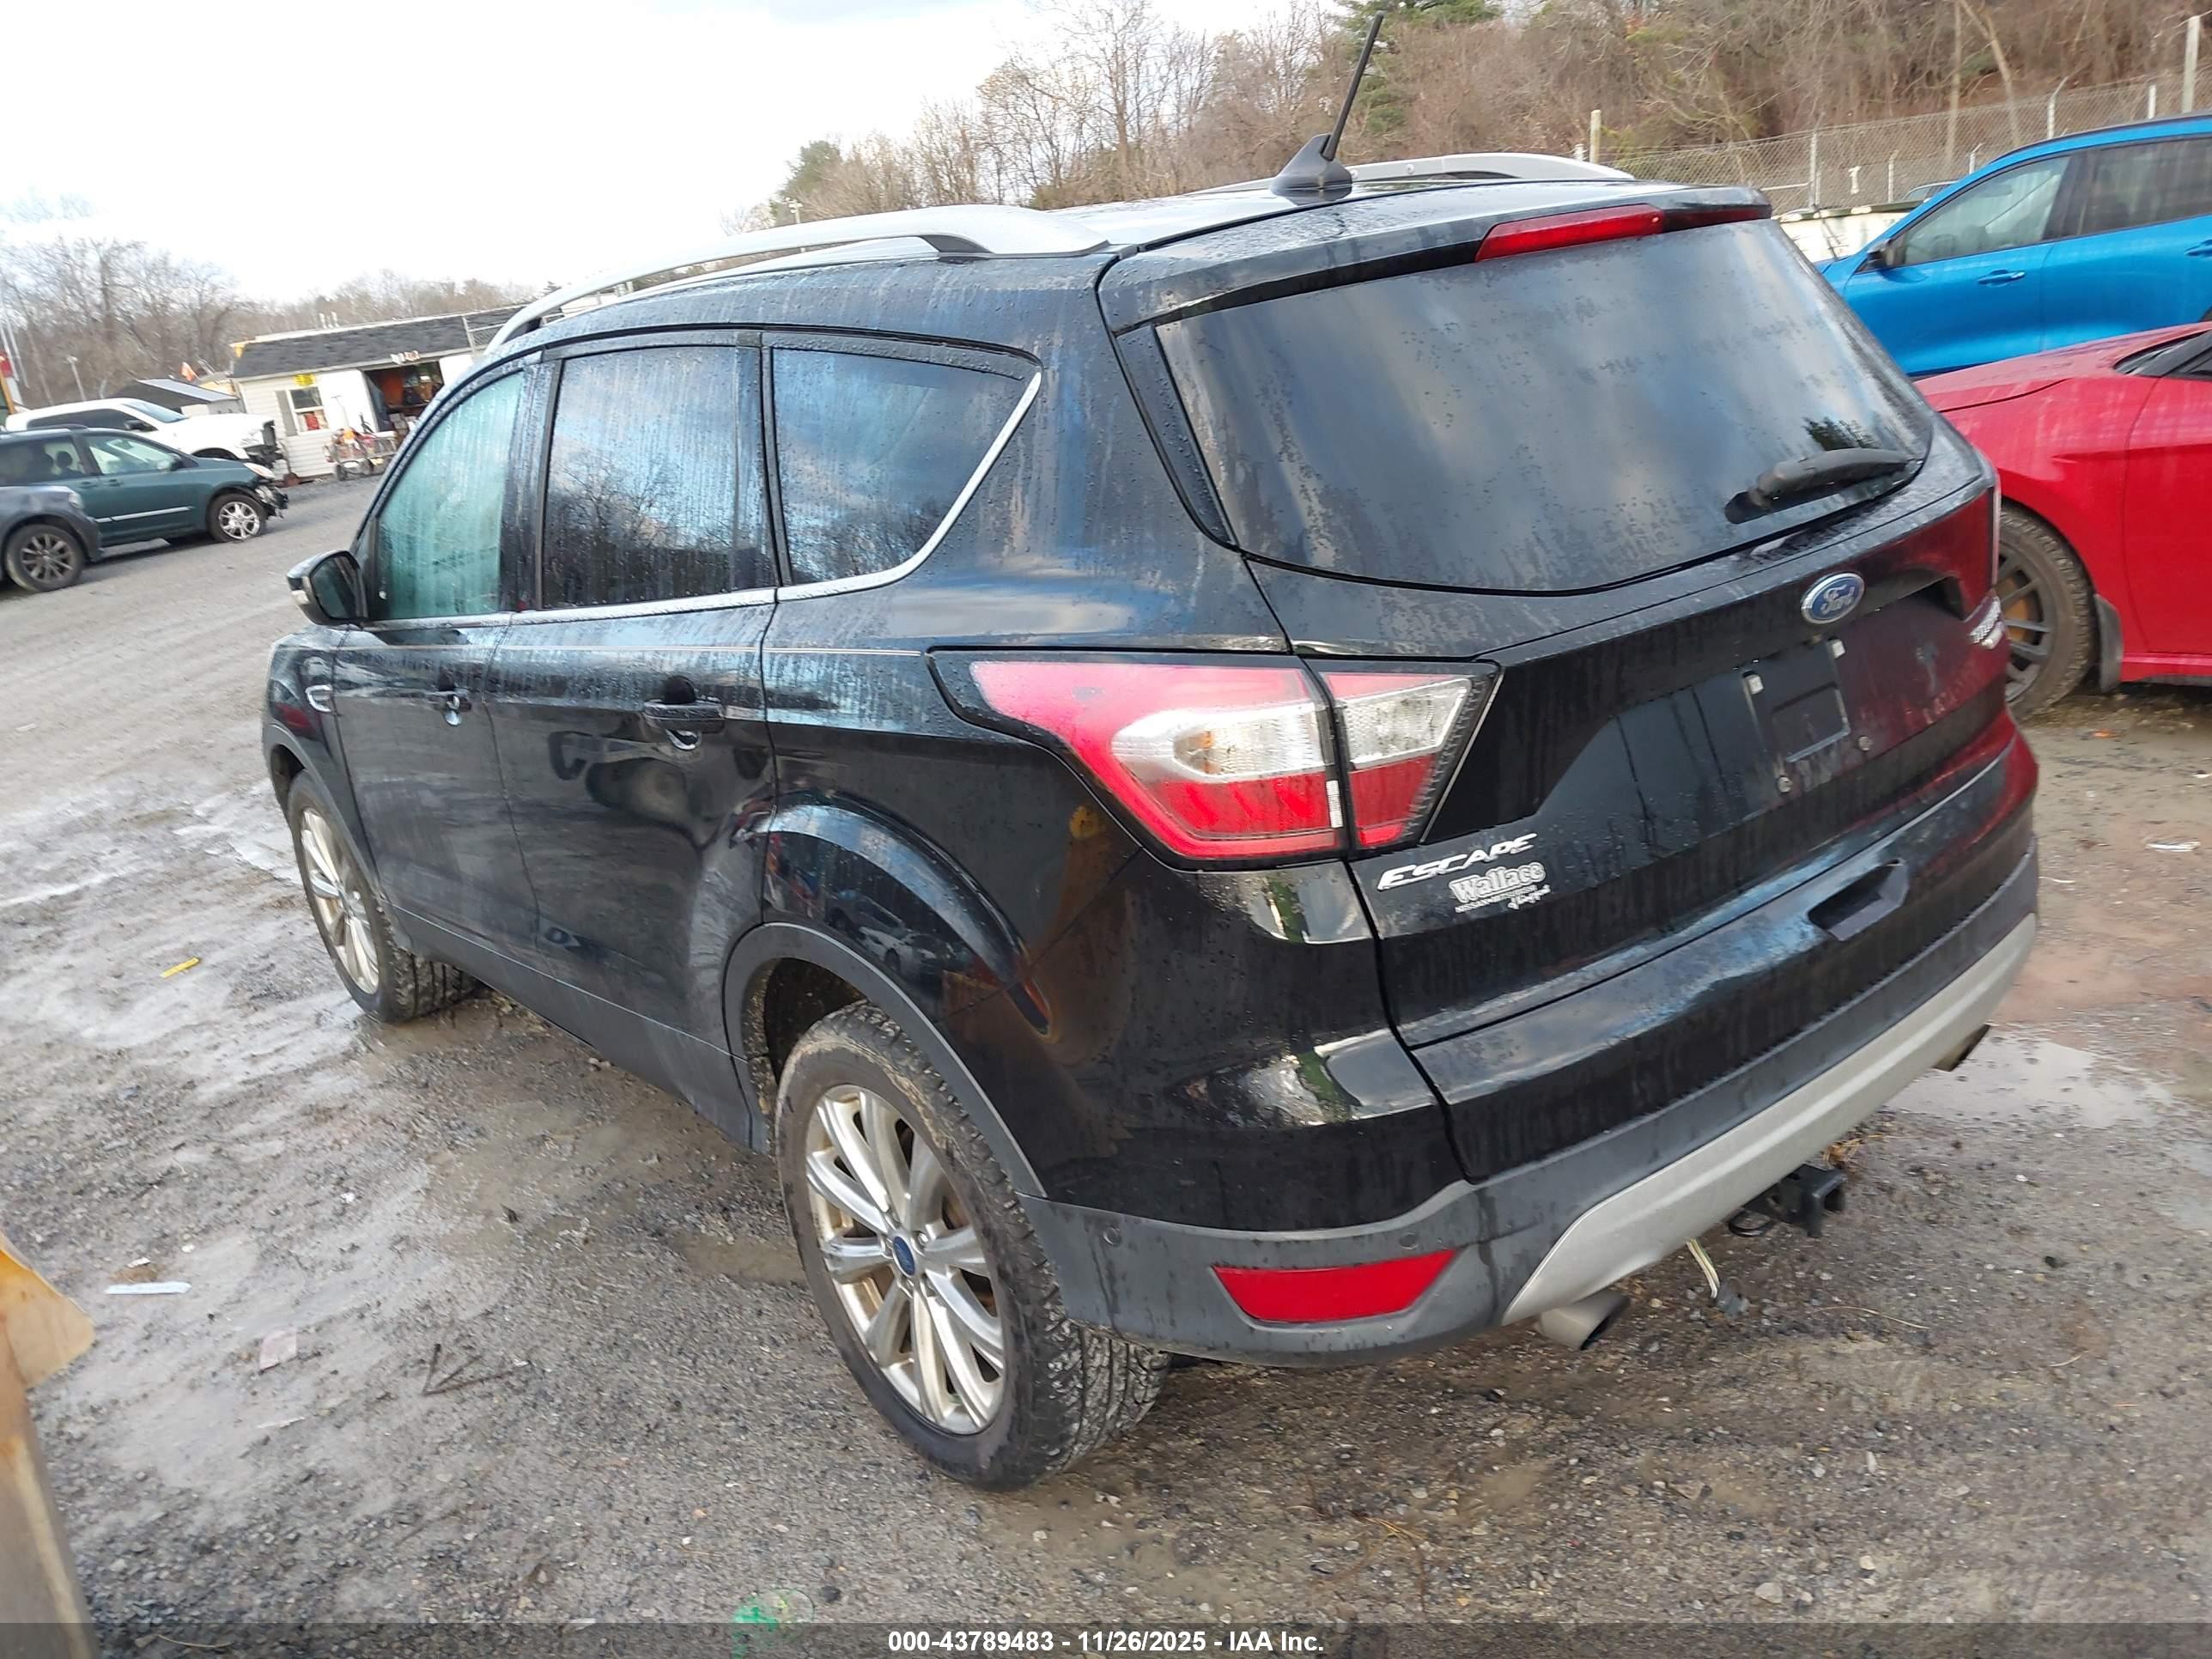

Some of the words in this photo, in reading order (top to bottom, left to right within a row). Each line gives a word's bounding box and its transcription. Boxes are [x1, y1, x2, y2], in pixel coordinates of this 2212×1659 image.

[1820, 584, 1856, 616] Ford
[1376, 832, 1538, 891] ESCAPE
[1449, 862, 1546, 903] Wallace
